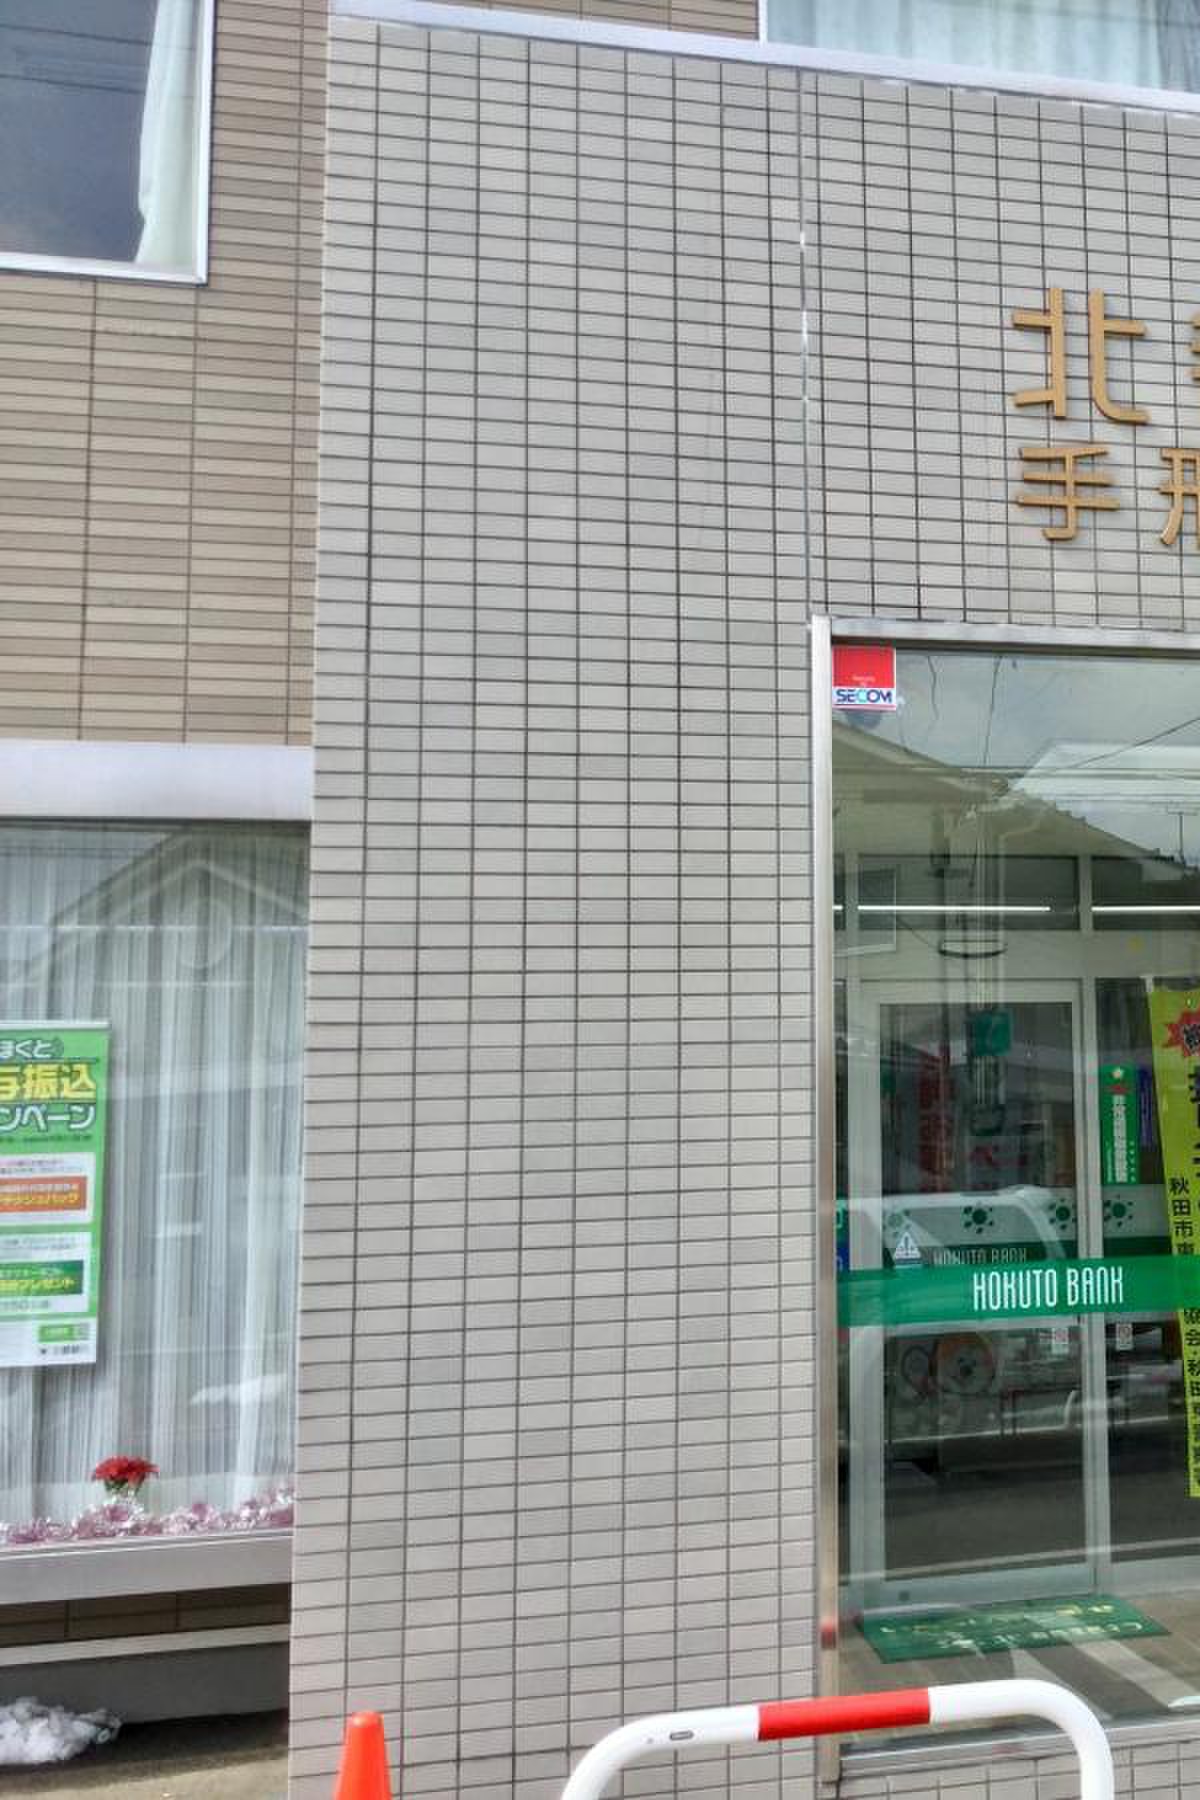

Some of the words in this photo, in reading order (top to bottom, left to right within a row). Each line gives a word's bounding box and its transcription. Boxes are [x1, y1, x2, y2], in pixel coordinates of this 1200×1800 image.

[836, 689, 892, 703] SECOM
[973, 1269, 1058, 1311] HOKUTO
[1066, 1266, 1124, 1306] BANK
